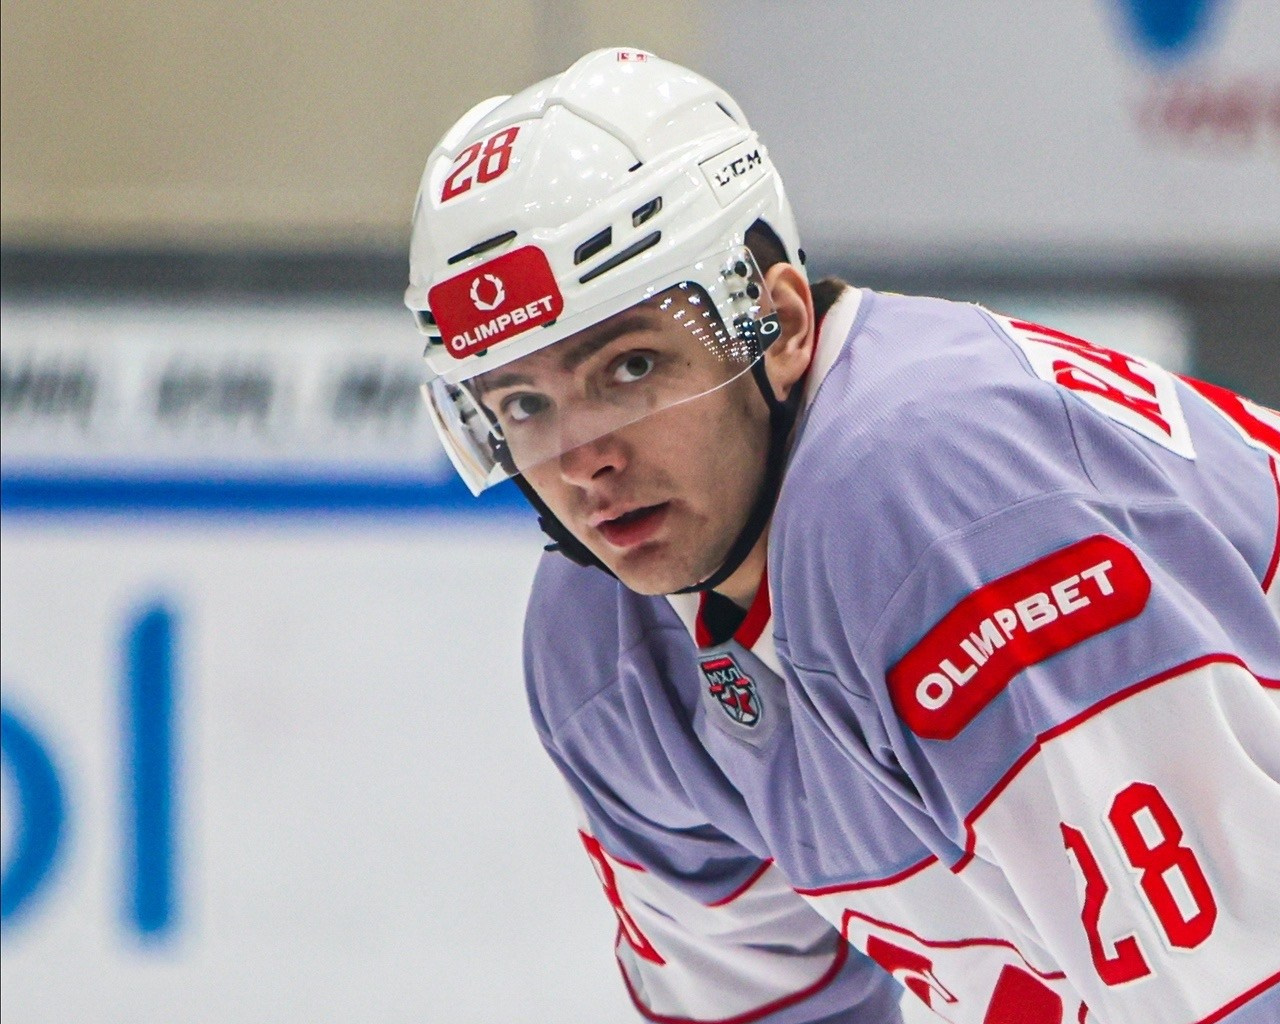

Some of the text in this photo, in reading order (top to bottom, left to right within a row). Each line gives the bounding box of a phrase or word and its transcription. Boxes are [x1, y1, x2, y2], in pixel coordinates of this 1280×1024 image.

[441, 127, 521, 203] 28
[451, 295, 554, 352] OLIMPBET
[915, 559, 1114, 711] OLIMPBET
[1059, 782, 1218, 986] 28
